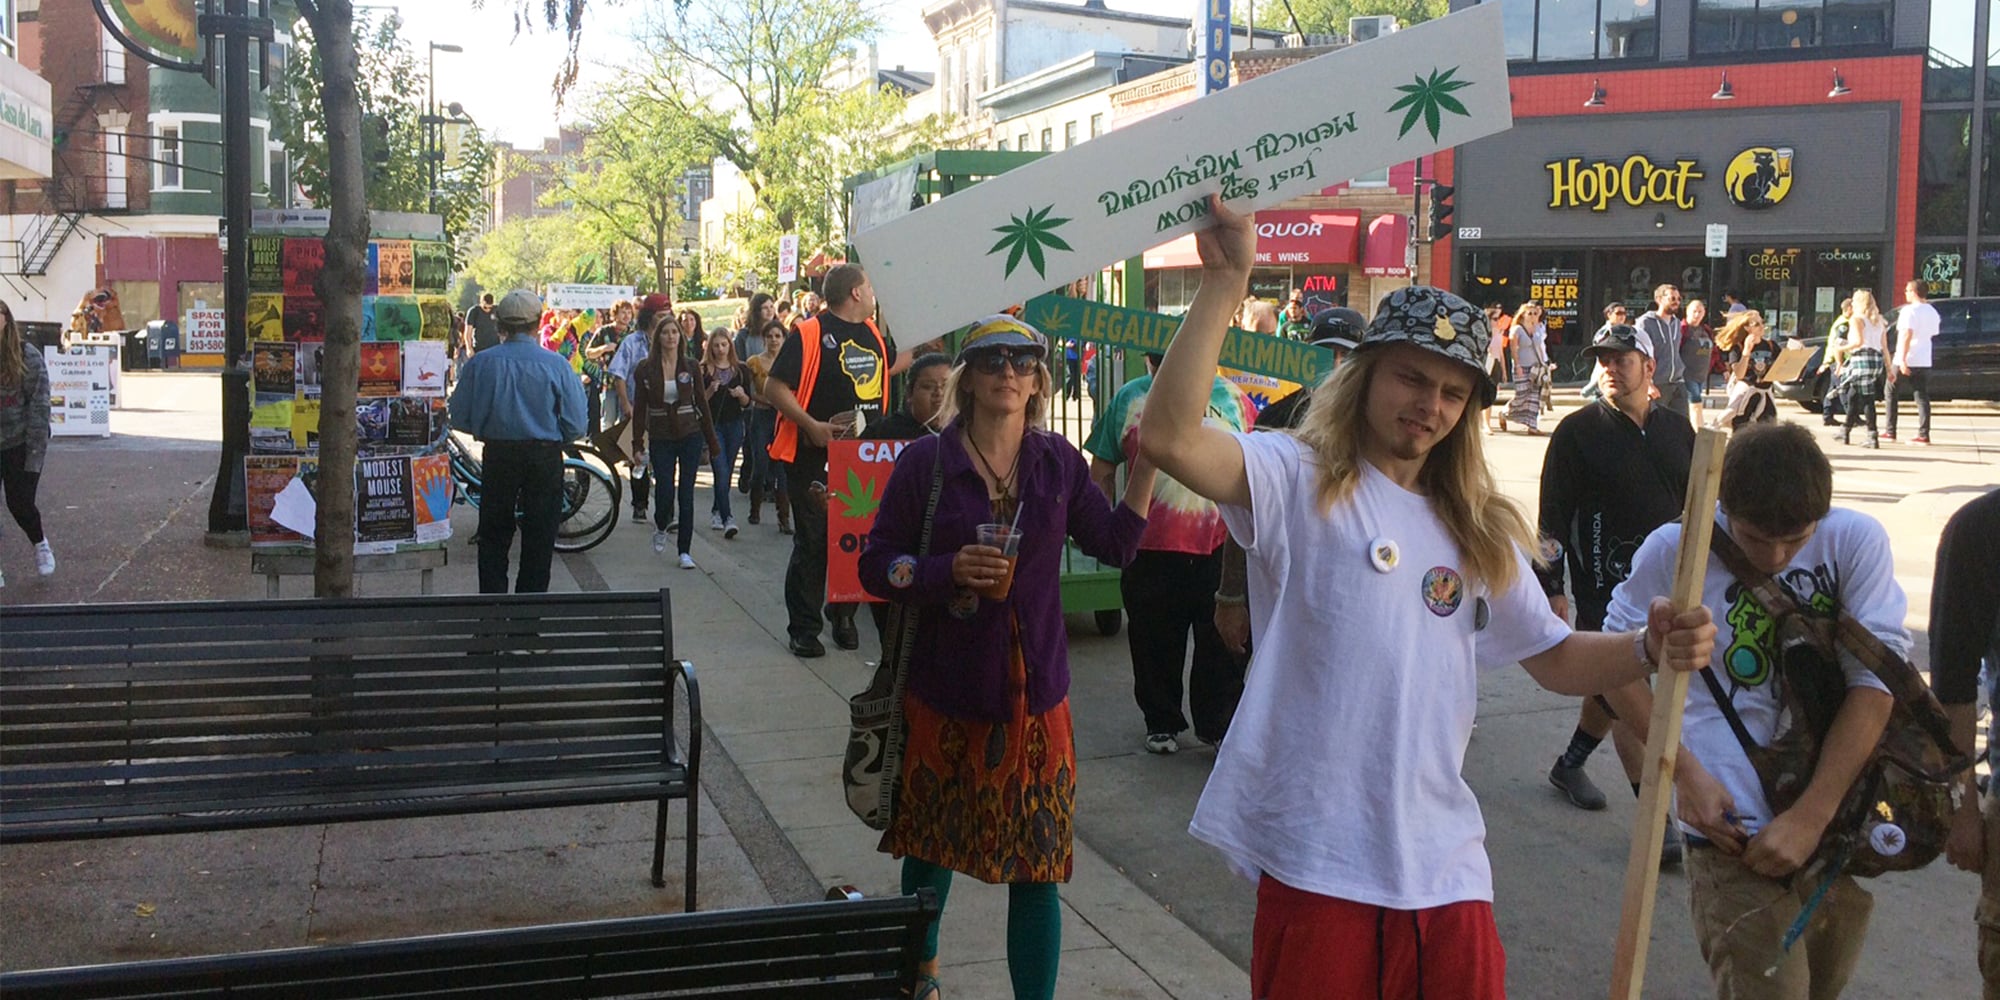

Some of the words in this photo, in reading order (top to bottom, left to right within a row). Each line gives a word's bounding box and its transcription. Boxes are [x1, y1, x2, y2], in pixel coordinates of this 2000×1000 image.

[1268, 147, 1323, 191] Just
[1220, 178, 1260, 201] Say
[1546, 155, 1703, 210] HopCat
[1154, 195, 1214, 233] NOW
[1254, 223, 1324, 238] IQUOR
[1460, 229, 1480, 238] 222
[252, 238, 280, 251] MODEST
[254, 251, 278, 264] MOUSE
[1255, 252, 1272, 262] INE
[1278, 252, 1310, 262] WINES
[1748, 254, 1797, 266] CRAFT
[1819, 252, 1872, 261] COCKTAILS
[1755, 268, 1791, 280] BEER
[1303, 275, 1336, 291] ATM
[1530, 285, 1578, 299] BEER
[1543, 299, 1565, 308] BAR
[190, 340, 225, 350] 513-580
[1081, 305, 1181, 350] LEGALIZ
[1221, 331, 1318, 383] ARMING
[363, 459, 404, 478] MODEST
[367, 477, 402, 497] MOUSE
[1593, 512, 1602, 554] PANDA
[1593, 556, 1604, 589] TEAM
